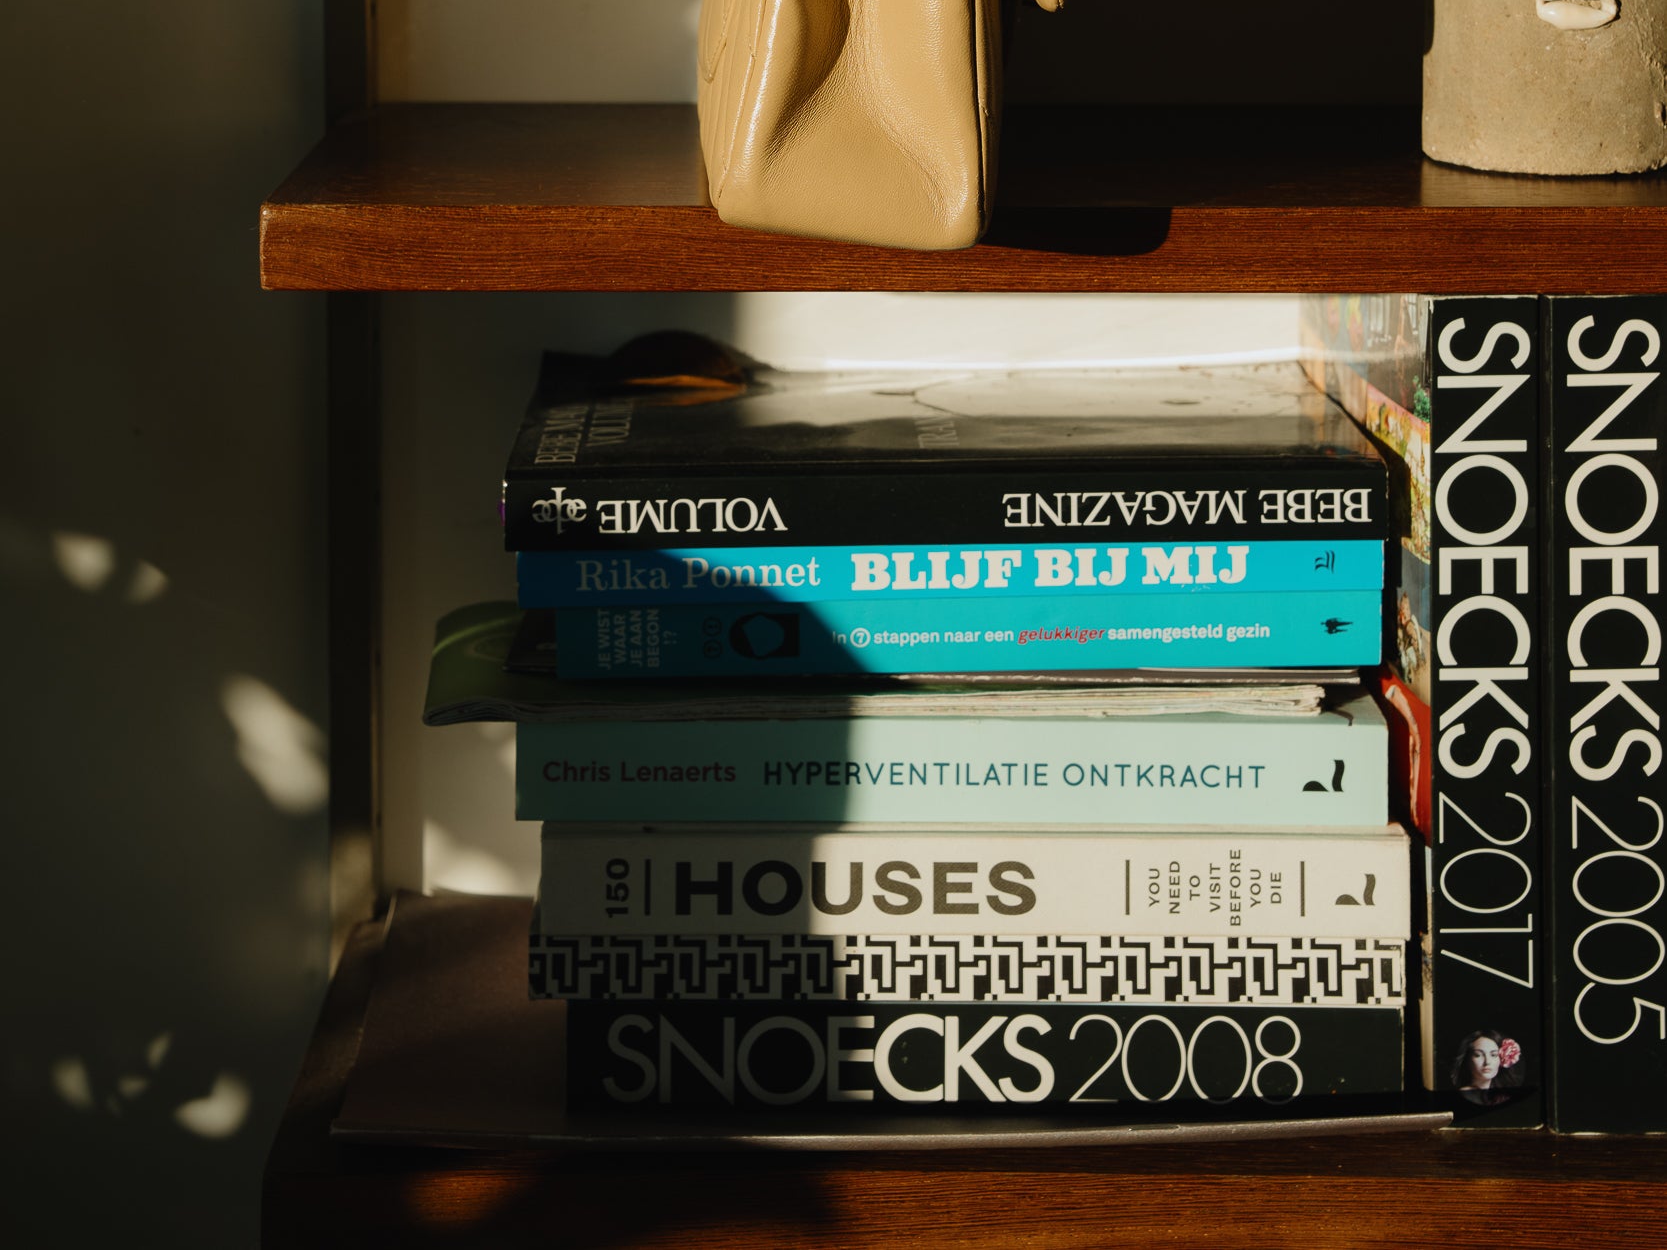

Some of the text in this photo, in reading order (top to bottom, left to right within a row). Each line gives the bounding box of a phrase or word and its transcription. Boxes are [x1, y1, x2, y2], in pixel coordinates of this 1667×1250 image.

[596, 497, 788, 534] VOLUME
[1001, 488, 1373, 528] BEBE MAGAZINE
[575, 556, 821, 592] Rika Ponnet
[850, 545, 1250, 592] BLIJF BIJ MIJ
[597, 608, 611, 670] JE WIST
[614, 614, 627, 664] WAAR
[629, 609, 642, 668] JE AAN
[646, 608, 660, 669] BEGON
[873, 630, 940, 647] stappen
[944, 630, 981, 643] naar
[984, 630, 1014, 643] een
[1017, 626, 1105, 645] gelukkiger
[1107, 624, 1223, 644] samengesteld
[1226, 623, 1270, 643] gezin
[1435, 317, 1534, 989] SNOECKS 2017
[1565, 315, 1667, 1045] SNOECKS 2005
[542, 761, 736, 783] Chris Lenaerts
[764, 761, 1266, 789] HYPERVENTILATIE ONTKRACHT
[606, 858, 630, 918] 150
[675, 860, 1037, 916] HOUSES
[1148, 867, 1161, 907] YOU
[1169, 860, 1180, 914] NEED
[1190, 874, 1201, 901] TO
[1209, 862, 1221, 913] VISIT
[1230, 849, 1241, 926] BEFORE
[1250, 868, 1262, 907] YOU
[1270, 871, 1282, 904] DIE
[602, 1013, 1304, 1106] SNOECKS 2008
